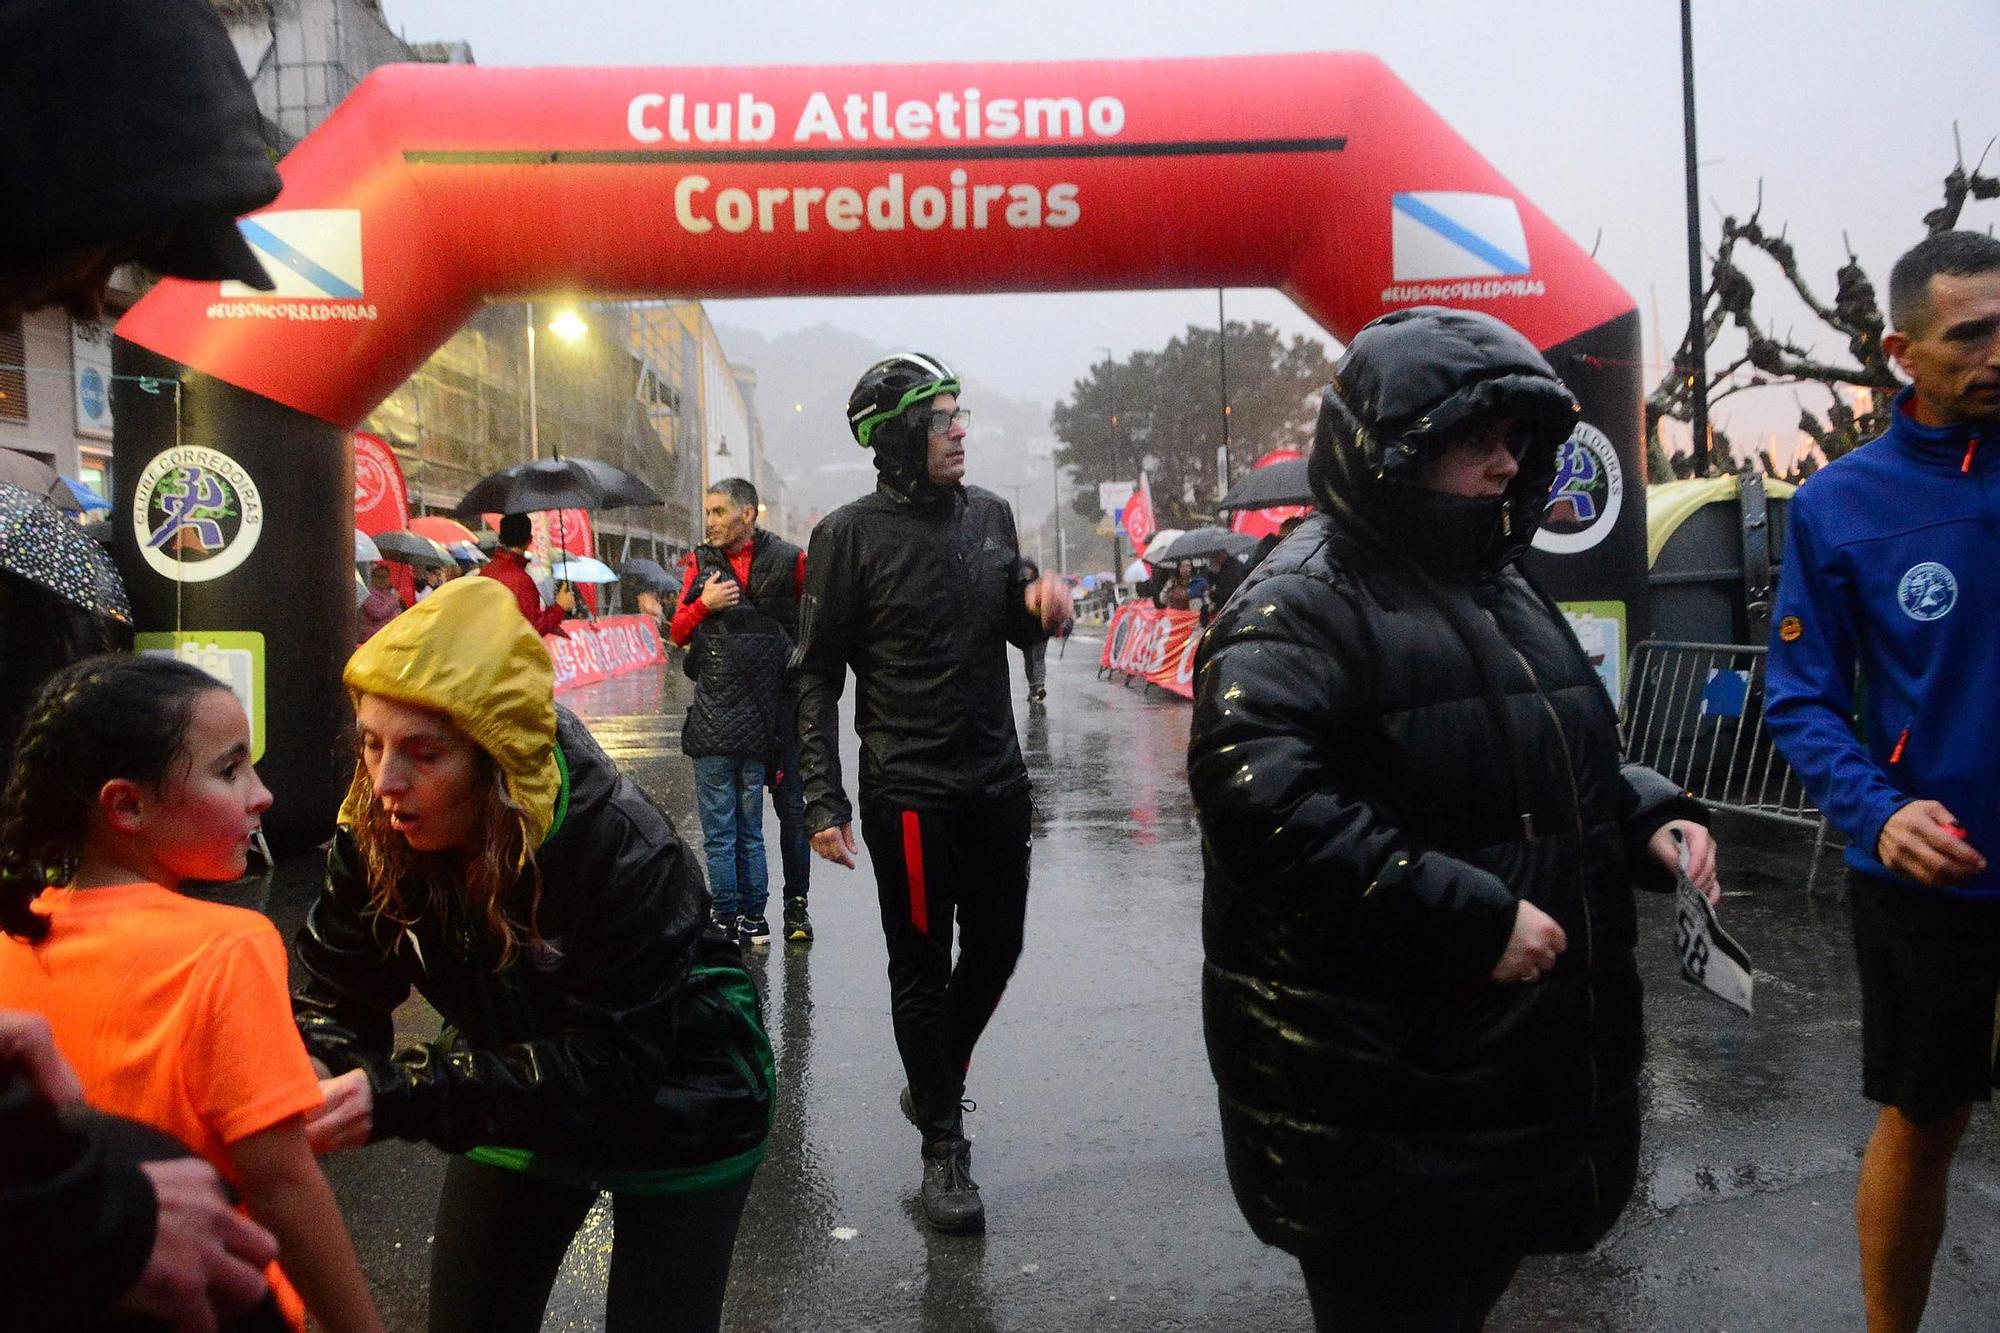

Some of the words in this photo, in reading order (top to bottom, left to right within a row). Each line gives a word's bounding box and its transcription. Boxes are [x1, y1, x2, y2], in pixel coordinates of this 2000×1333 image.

[627, 91, 776, 143] Club
[793, 86, 1126, 143] Atletismo
[673, 168, 1080, 233] Corredoiras
[158, 449, 260, 525] CORREDOIRAS
